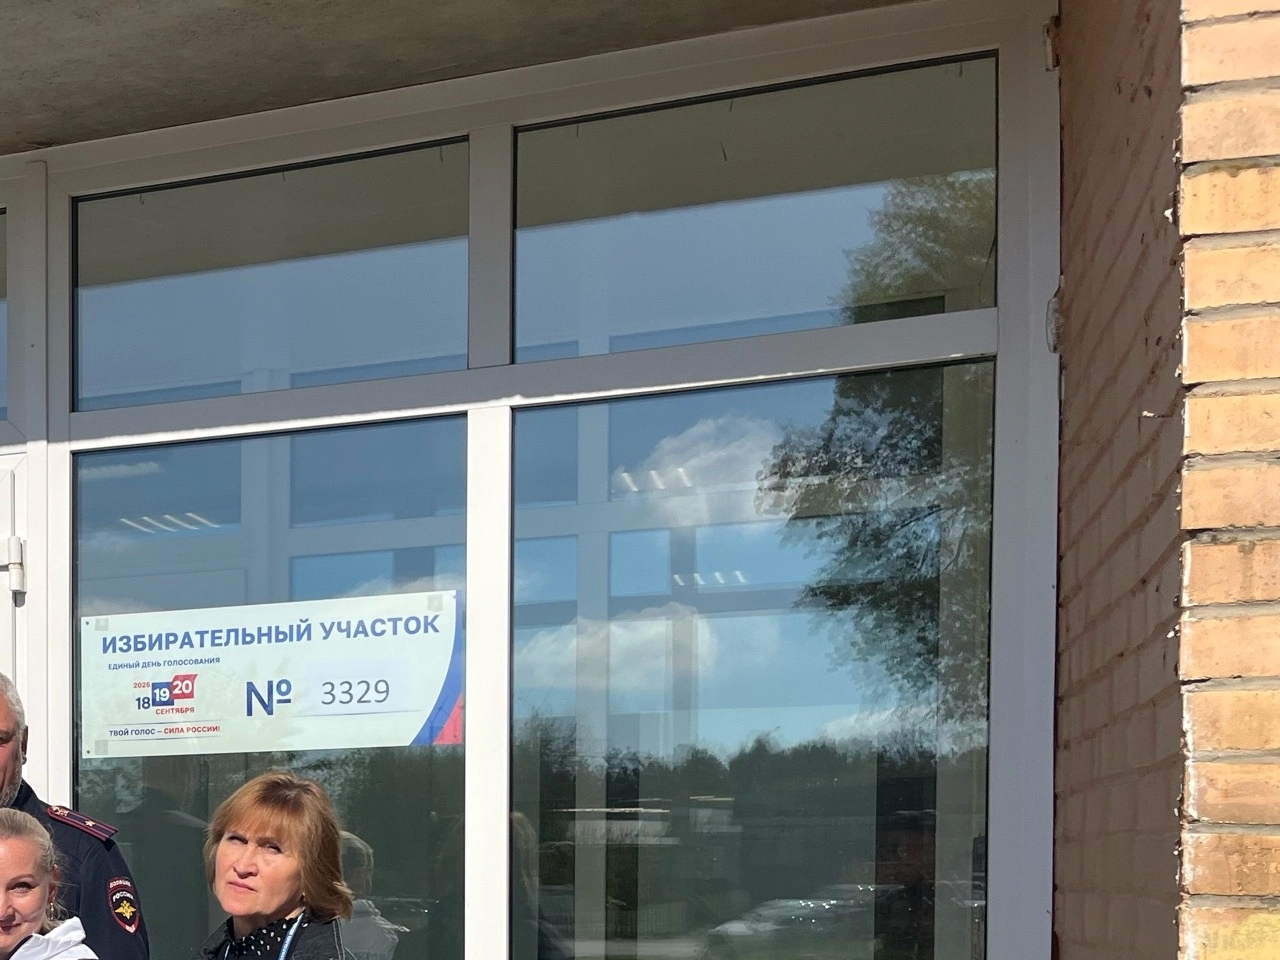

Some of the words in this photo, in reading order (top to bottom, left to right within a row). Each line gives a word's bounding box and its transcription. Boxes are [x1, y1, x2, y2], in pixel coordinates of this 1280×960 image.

[102, 618, 311, 654] ИЗБИРАТЕЛЬНЫЙ
[319, 615, 440, 640] УЧАСТОК
[108, 661, 140, 670] ЕДИНЫЙ
[142, 660, 161, 668] ДЕНЬ
[163, 657, 220, 667] ГОЛОСОВАНИЯ
[135, 697, 151, 710] 18
[154, 688, 170, 702] 19
[173, 680, 192, 694] 20
[246, 679, 292, 717] №
[321, 679, 390, 705] 3329
[155, 707, 194, 715] СЕНТЯБРЯ
[109, 728, 129, 736] ТВОЙ
[112, 891, 134, 902] РОССИЯ
